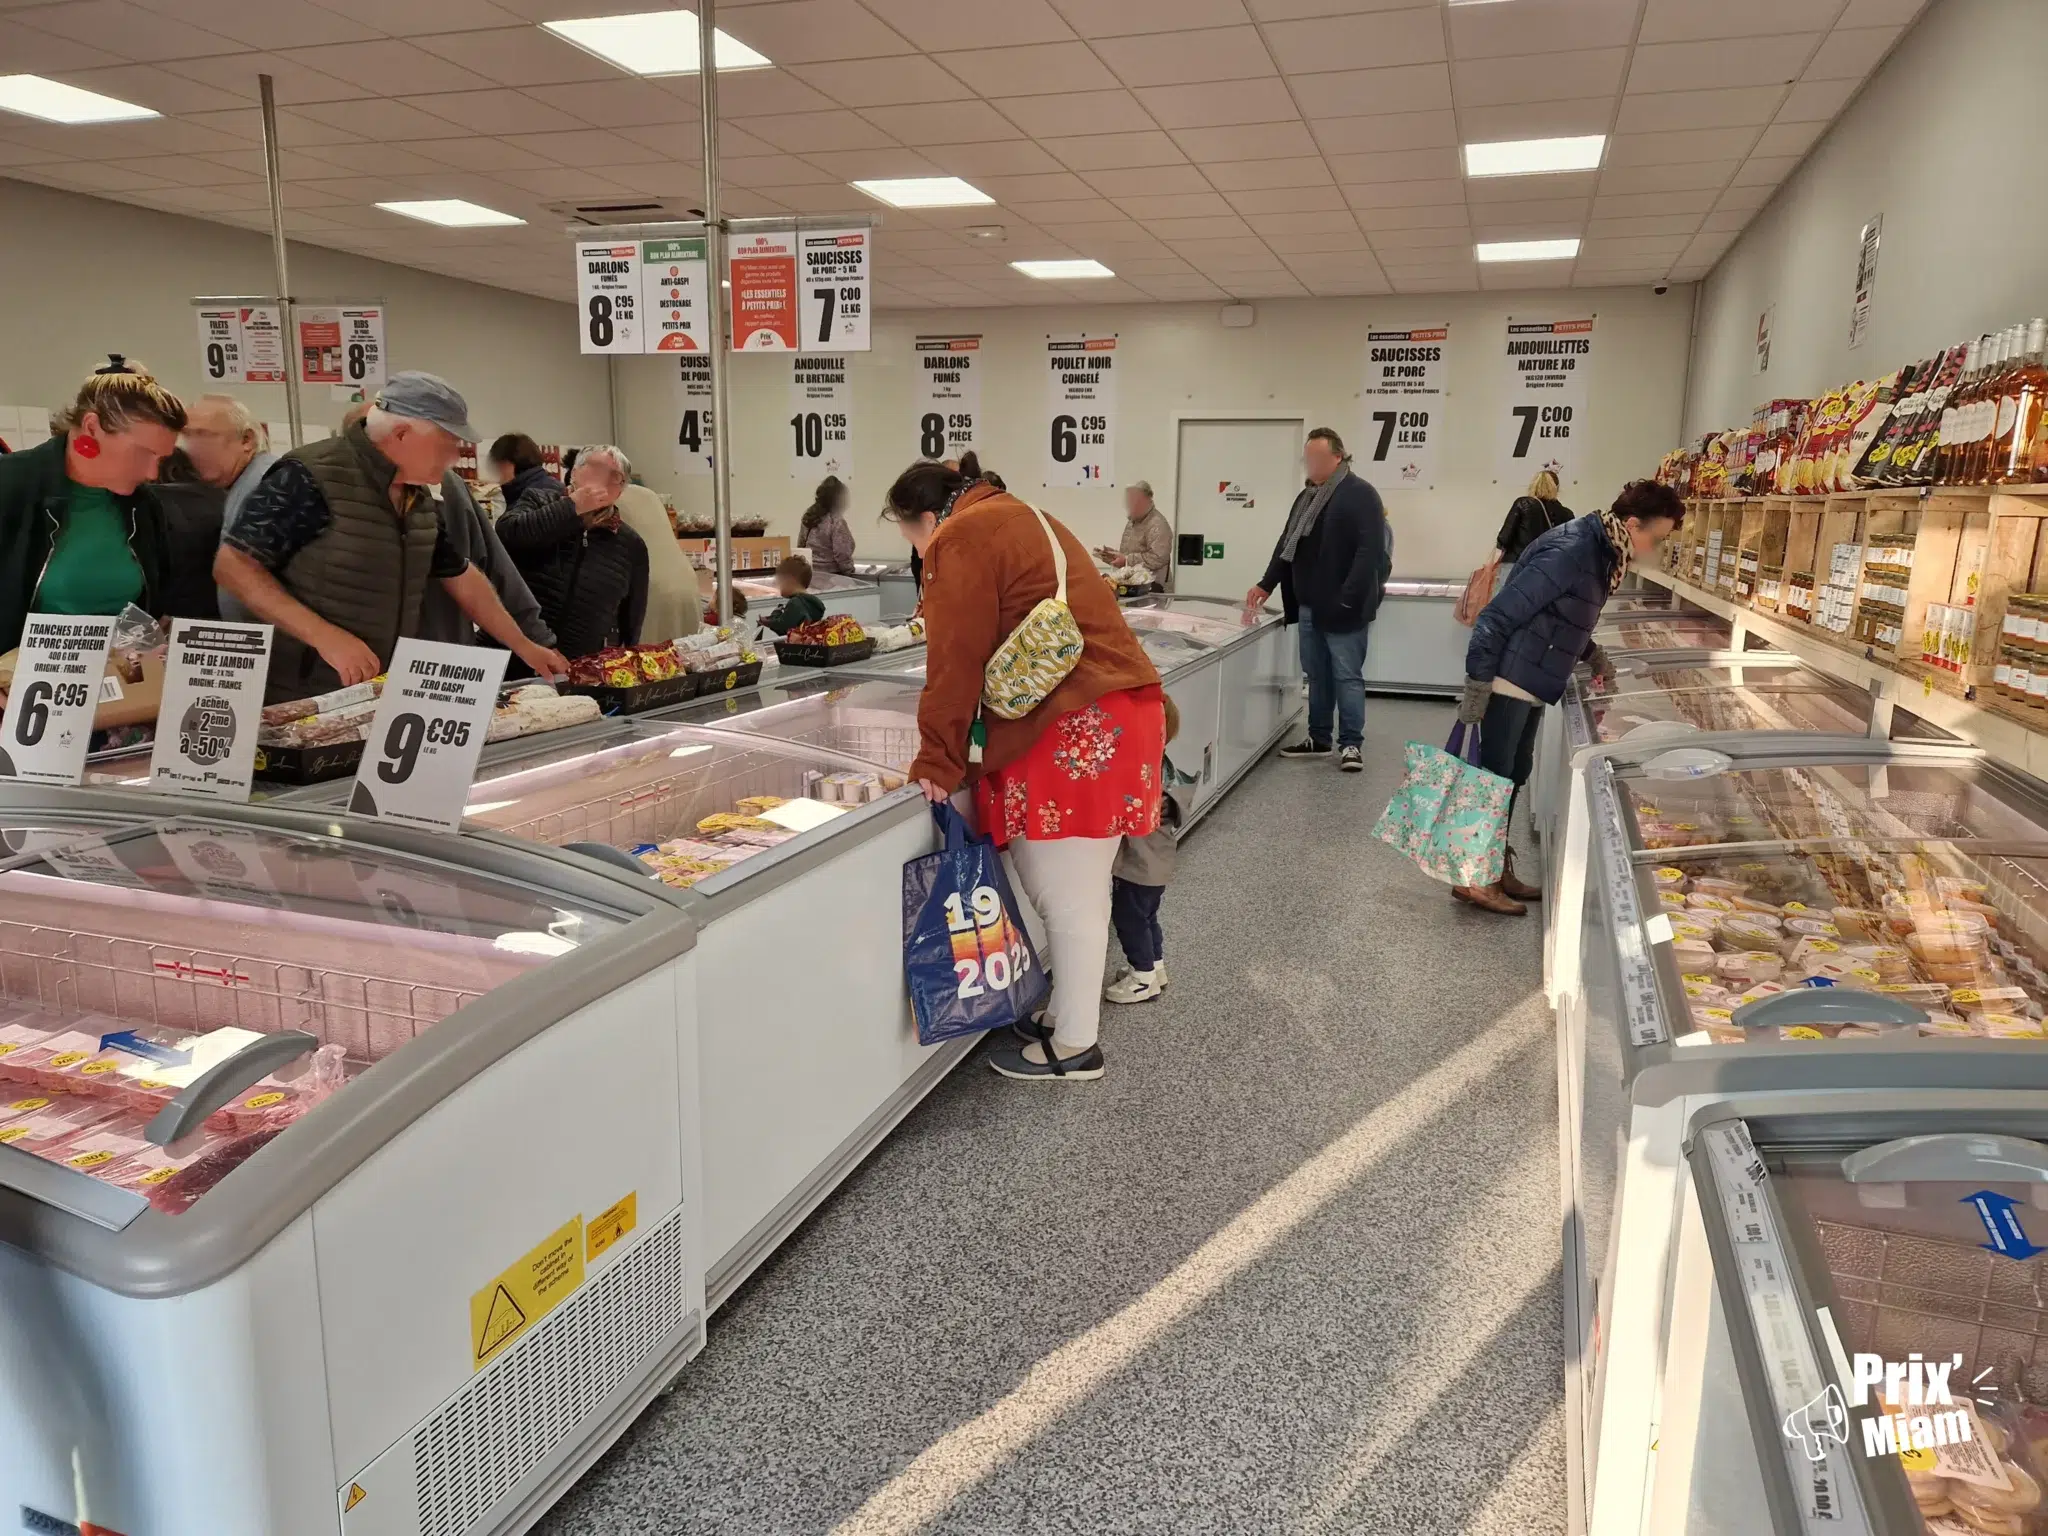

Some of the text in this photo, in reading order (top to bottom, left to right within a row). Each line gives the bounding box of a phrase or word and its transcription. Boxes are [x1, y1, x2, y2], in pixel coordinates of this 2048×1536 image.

[806, 250, 863, 266] SAUCISSES
[589, 261, 630, 274] DARLONS
[812, 265, 857, 275] DE PORC 5 KG
[660, 277, 690, 286] ANTI-GASPI
[754, 288, 787, 298] ESSENTIELS
[746, 300, 766, 310] PETITS
[841, 303, 861, 314] LE KG
[589, 294, 634, 346] 8 €95
[616, 310, 634, 320] LE KG
[813, 288, 836, 342] 7
[209, 320, 229, 329] FILETS
[662, 321, 691, 330] PETITS PRIX
[1507, 339, 1590, 355] ANDOUILLETTES
[207, 343, 225, 378] 9
[1370, 347, 1441, 362] SAUCISSES
[348, 343, 366, 380] 8
[794, 358, 845, 370] ANDOUILLE
[924, 356, 970, 369] DARLONS
[1051, 356, 1112, 370] POULET NOIR
[1518, 358, 1576, 371] NATURE X8
[681, 371, 711, 381] DE POUL
[795, 373, 845, 383] DE BRETAGNE
[933, 371, 961, 383] FUMÉS
[1061, 371, 1100, 384] CONGELÉ
[1382, 366, 1426, 378] DE PORC
[679, 410, 701, 452] 4
[790, 412, 846, 458] 10 €95
[824, 430, 846, 441] LE KG
[921, 413, 972, 459] 8 €95
[948, 429, 973, 442] PIÈCE
[1372, 411, 1429, 462] 7 €00
[1398, 430, 1427, 443] LE KG
[1512, 405, 1573, 458] 7 €00
[1540, 425, 1570, 438] LE KG
[1051, 414, 1106, 463] 6 €95
[1081, 433, 1105, 445] LE KG
[29, 623, 110, 638] TRANCHES DE CARRE
[26, 637, 106, 651] DE PORC SUPÉRIEUR
[48, 651, 80, 661] 400 G ENV
[181, 651, 256, 670] RAPÉ DE JAMBON
[33, 663, 87, 674] ORIGINE FRANCE
[409, 659, 485, 682] FILET MIGNON
[188, 677, 242, 690] ORIGINE FRANCE
[420, 679, 465, 694] ZERO GASPI
[195, 697, 230, 710] 1 acheté
[402, 688, 477, 706] 1KG ENV ORIGINE FRANCE
[15, 681, 89, 747] 6 €95
[189, 712, 230, 732] le 2ème
[180, 733, 230, 759] à -50%
[377, 712, 472, 784] 9 €95
[423, 746, 430, 754] LE
[943, 886, 1001, 931] 19
[532, 1236, 573, 1272] Don't move the
[540, 1255, 560, 1275] cabinet
[538, 1285, 547, 1296] the
